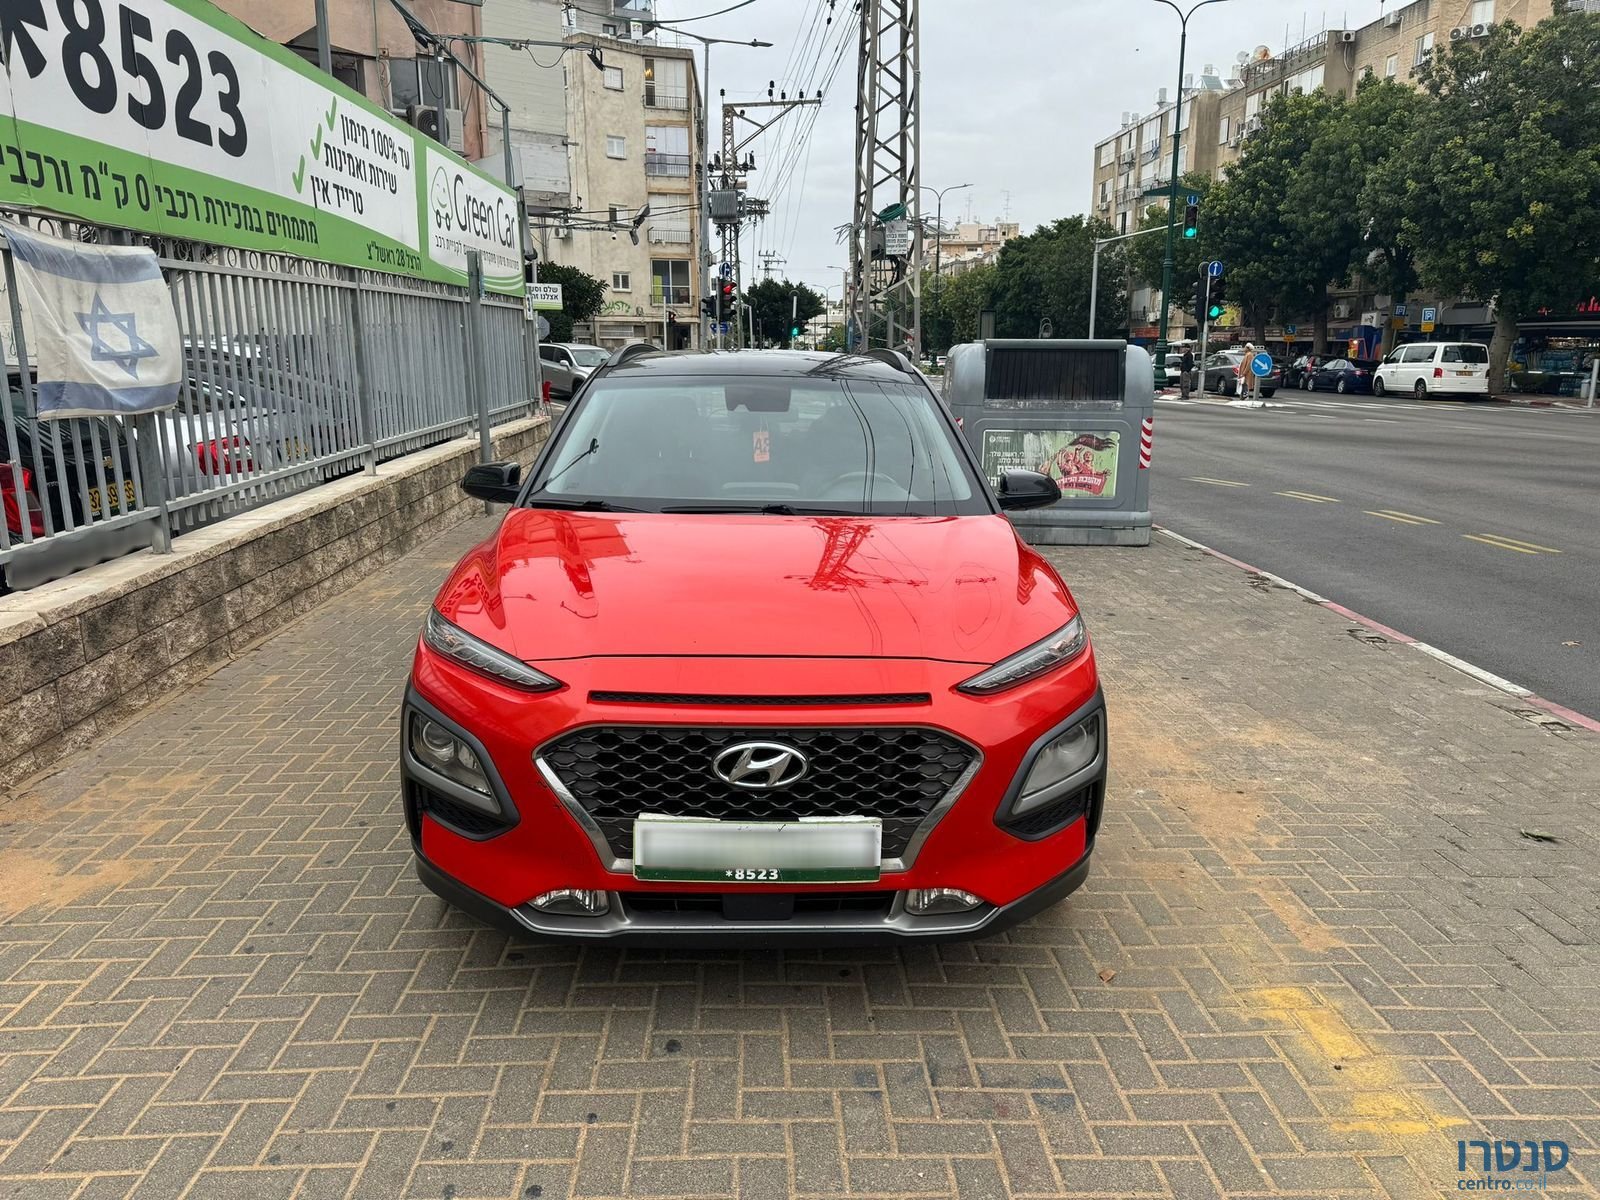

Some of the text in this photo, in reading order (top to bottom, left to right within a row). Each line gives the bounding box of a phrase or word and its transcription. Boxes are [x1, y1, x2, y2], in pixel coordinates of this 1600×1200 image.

[341, 114, 410, 170] עד 100% מימון
[324, 142, 397, 194] שירות ואמינות
[135, 173, 150, 211] 0
[155, 184, 200, 221] רכבי
[310, 175, 363, 215] טרייד אין
[203, 196, 264, 233] במכירת
[266, 210, 318, 244] מתמחים
[454, 174, 515, 249] Green Car
[396, 248, 406, 267] 28
[435, 234, 446, 248] רכב
[405, 249, 421, 271] הרצל
[543, 285, 559, 293] שלם
